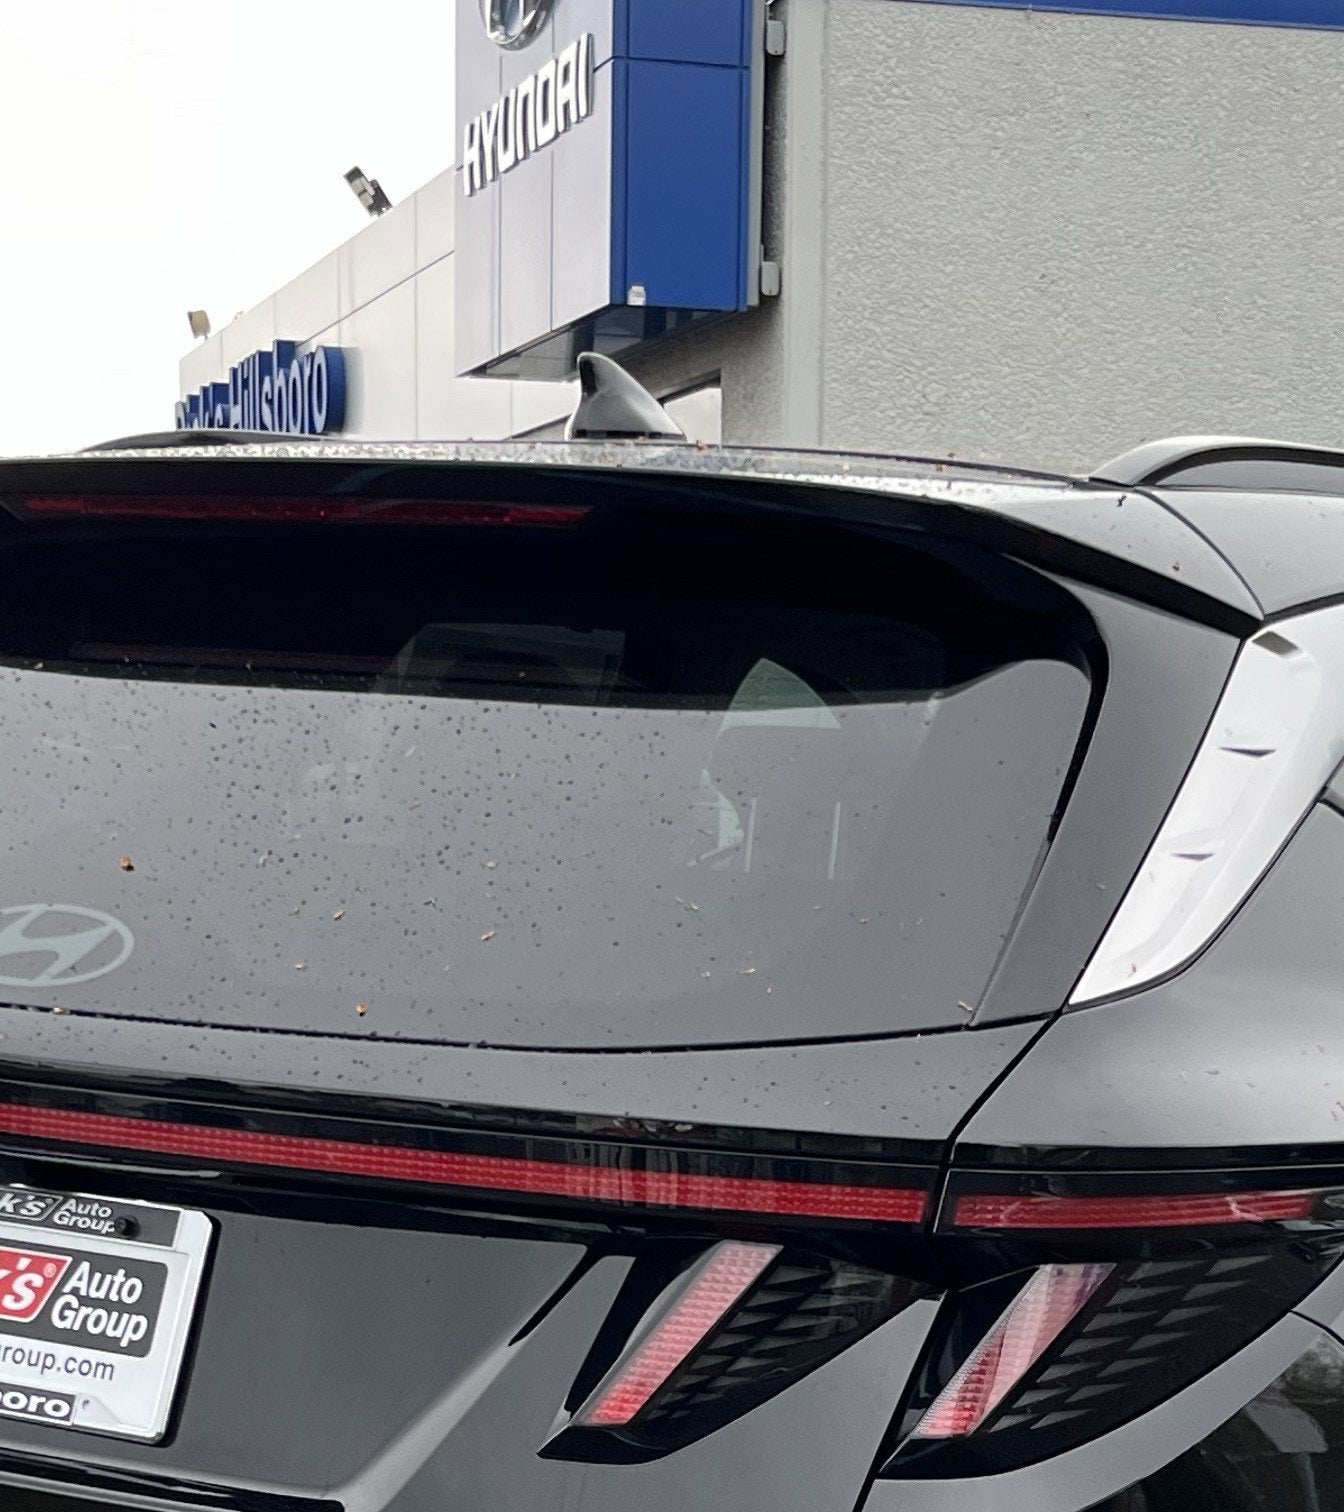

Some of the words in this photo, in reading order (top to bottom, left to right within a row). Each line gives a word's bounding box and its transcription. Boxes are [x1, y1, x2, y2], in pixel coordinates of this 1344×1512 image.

[463, 32, 590, 196] HYUNDAI
[229, 338, 337, 434] Hillsboro
[60, 1198, 112, 1218] Auto
[62, 1261, 143, 1304] Auto
[51, 1294, 148, 1347] Group
